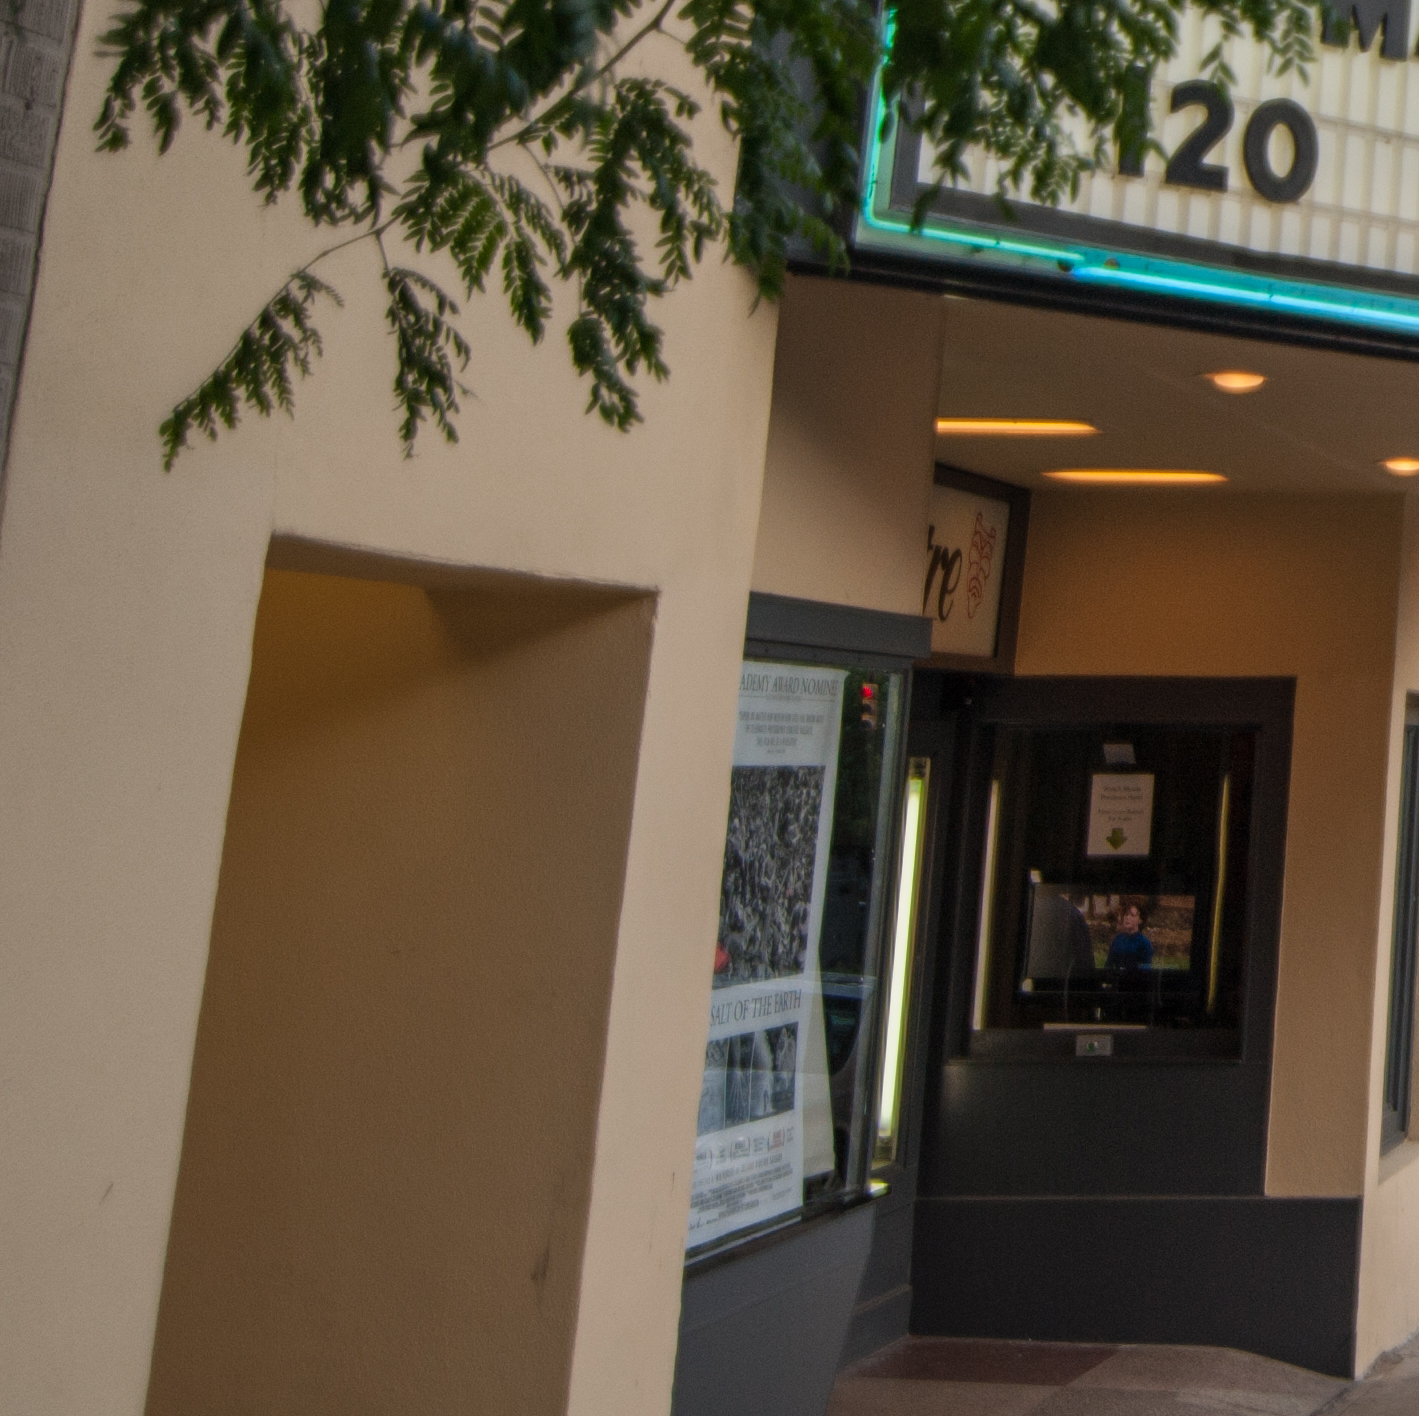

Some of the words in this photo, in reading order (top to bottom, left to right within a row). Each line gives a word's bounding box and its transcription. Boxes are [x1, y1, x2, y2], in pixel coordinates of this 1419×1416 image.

[710, 1002, 733, 1026] SALT
[733, 999, 750, 1021] OF
[752, 995, 773, 1018] THE
[774, 989, 803, 1014] EARTH
